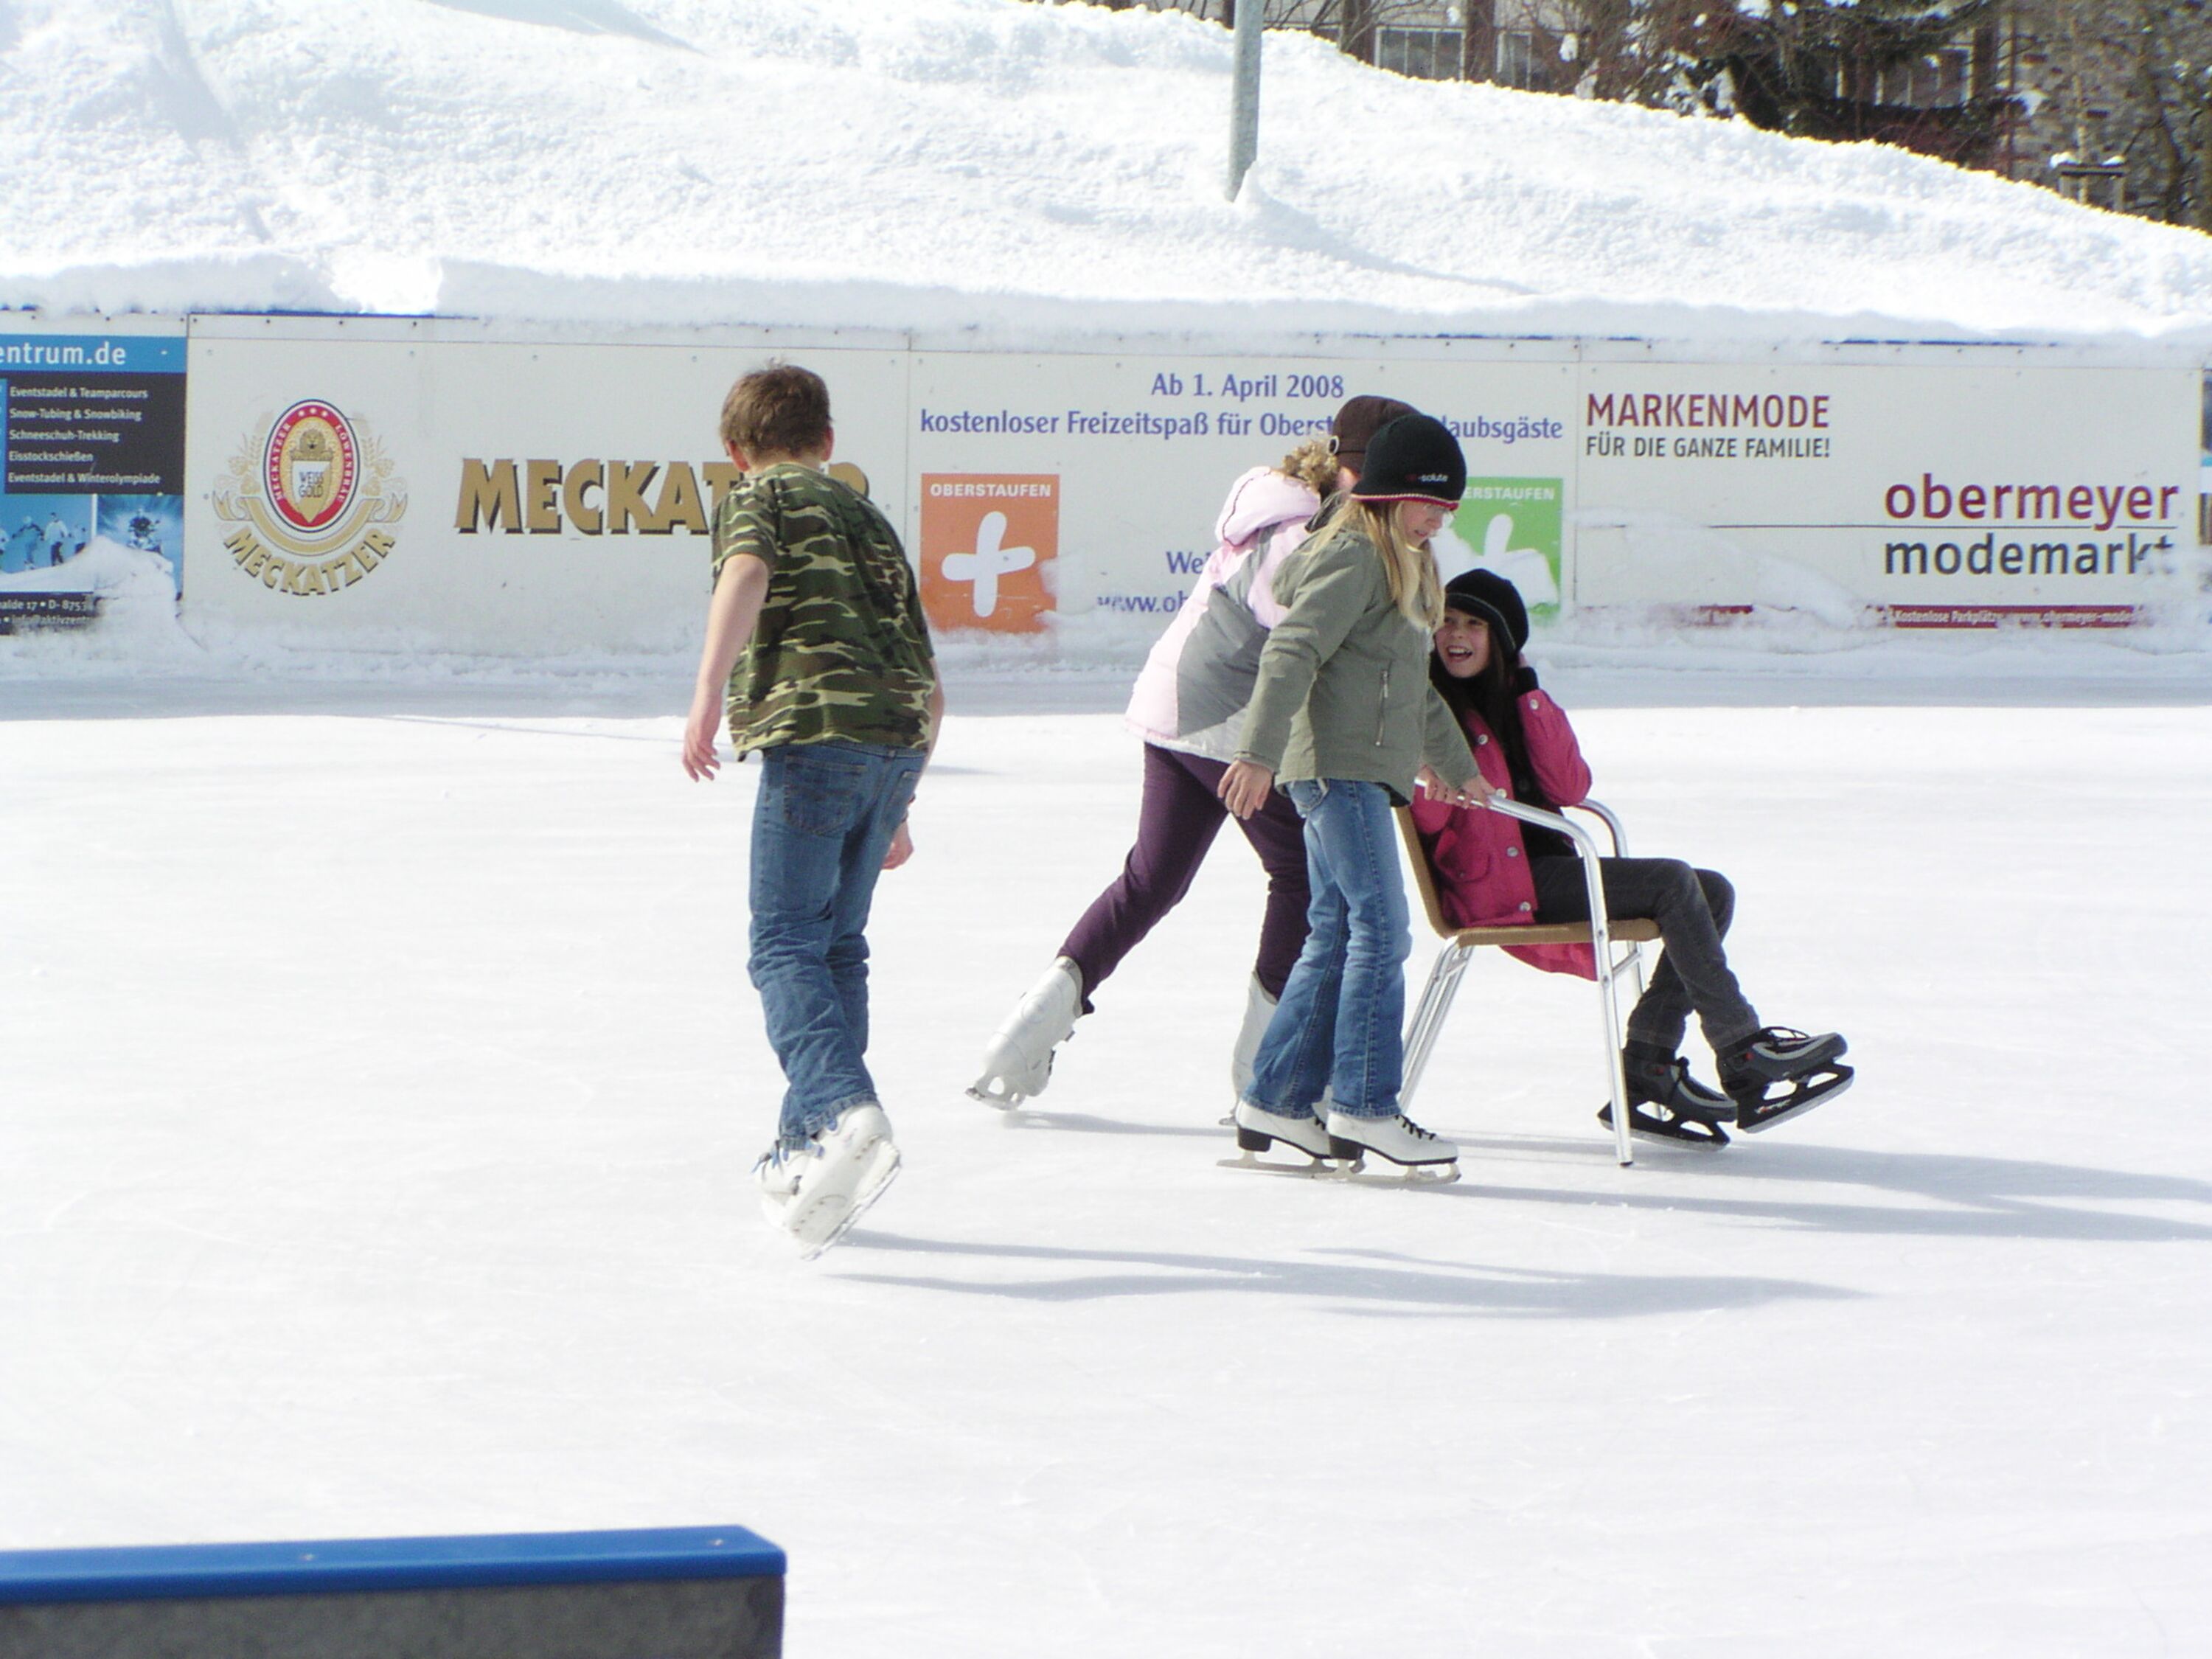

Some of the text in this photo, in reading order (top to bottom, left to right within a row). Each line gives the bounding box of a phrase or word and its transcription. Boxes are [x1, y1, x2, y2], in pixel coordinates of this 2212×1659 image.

[0, 341, 126, 365] ntrum.de
[10, 386, 148, 400] Eventstadel & Teamparcours
[1151, 373, 1343, 403] Ab 1. April 2008
[10, 408, 142, 422] Snow-Tubing & Snowbiking
[1587, 393, 1830, 428] MARKENMODE
[921, 408, 1059, 434] kostenloser
[1068, 410, 1208, 440] Freizeitspaß
[1217, 412, 1252, 435] für
[1260, 413, 1334, 437] Oberst
[9, 429, 120, 443] Schneeschuh-Trekking
[1586, 431, 1831, 459] FÜR DIE GANZE FAMILIE!
[9, 451, 94, 462] Eisstockschießen
[8, 472, 161, 486] Eventstadel & Winterolympiade
[298, 484, 324, 498] GOLD
[930, 483, 1052, 498] OBERSTAUFEN
[1885, 473, 2180, 531] obermeyer
[223, 526, 396, 596] MECKATZER
[1885, 532, 2174, 574] modemarkt
[27, 602, 38, 611] 17
